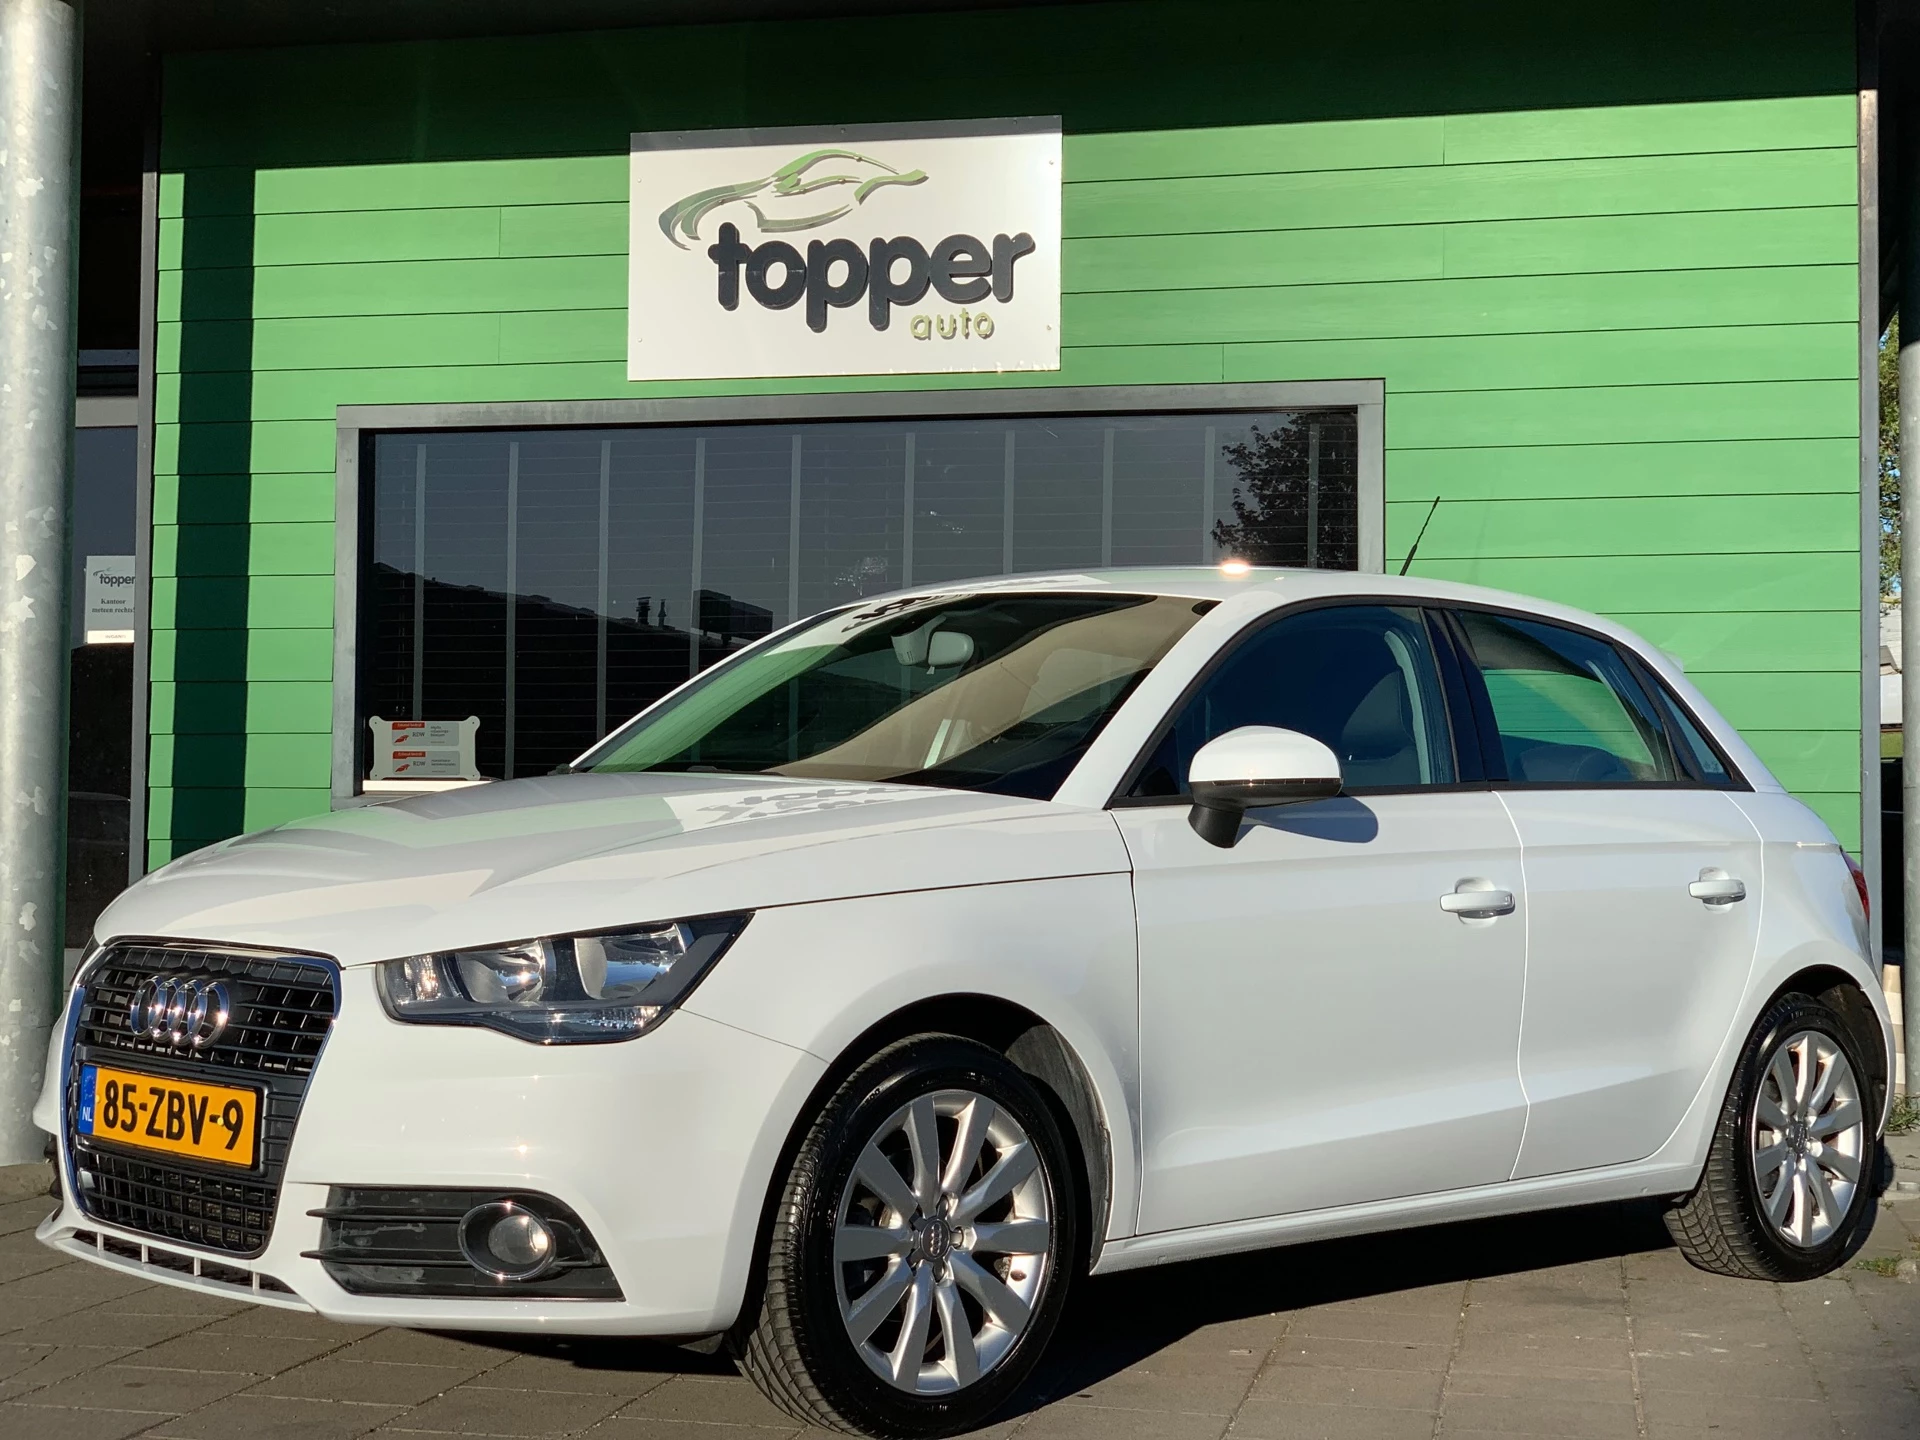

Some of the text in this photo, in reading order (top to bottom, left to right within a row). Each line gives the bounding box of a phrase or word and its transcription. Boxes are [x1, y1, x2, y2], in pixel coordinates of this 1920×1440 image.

[708, 222, 1036, 333] topper
[910, 308, 994, 340] auto
[99, 573, 136, 588] topper
[82, 1106, 93, 1122] NL
[103, 1079, 244, 1150] 85-ZBV-9
